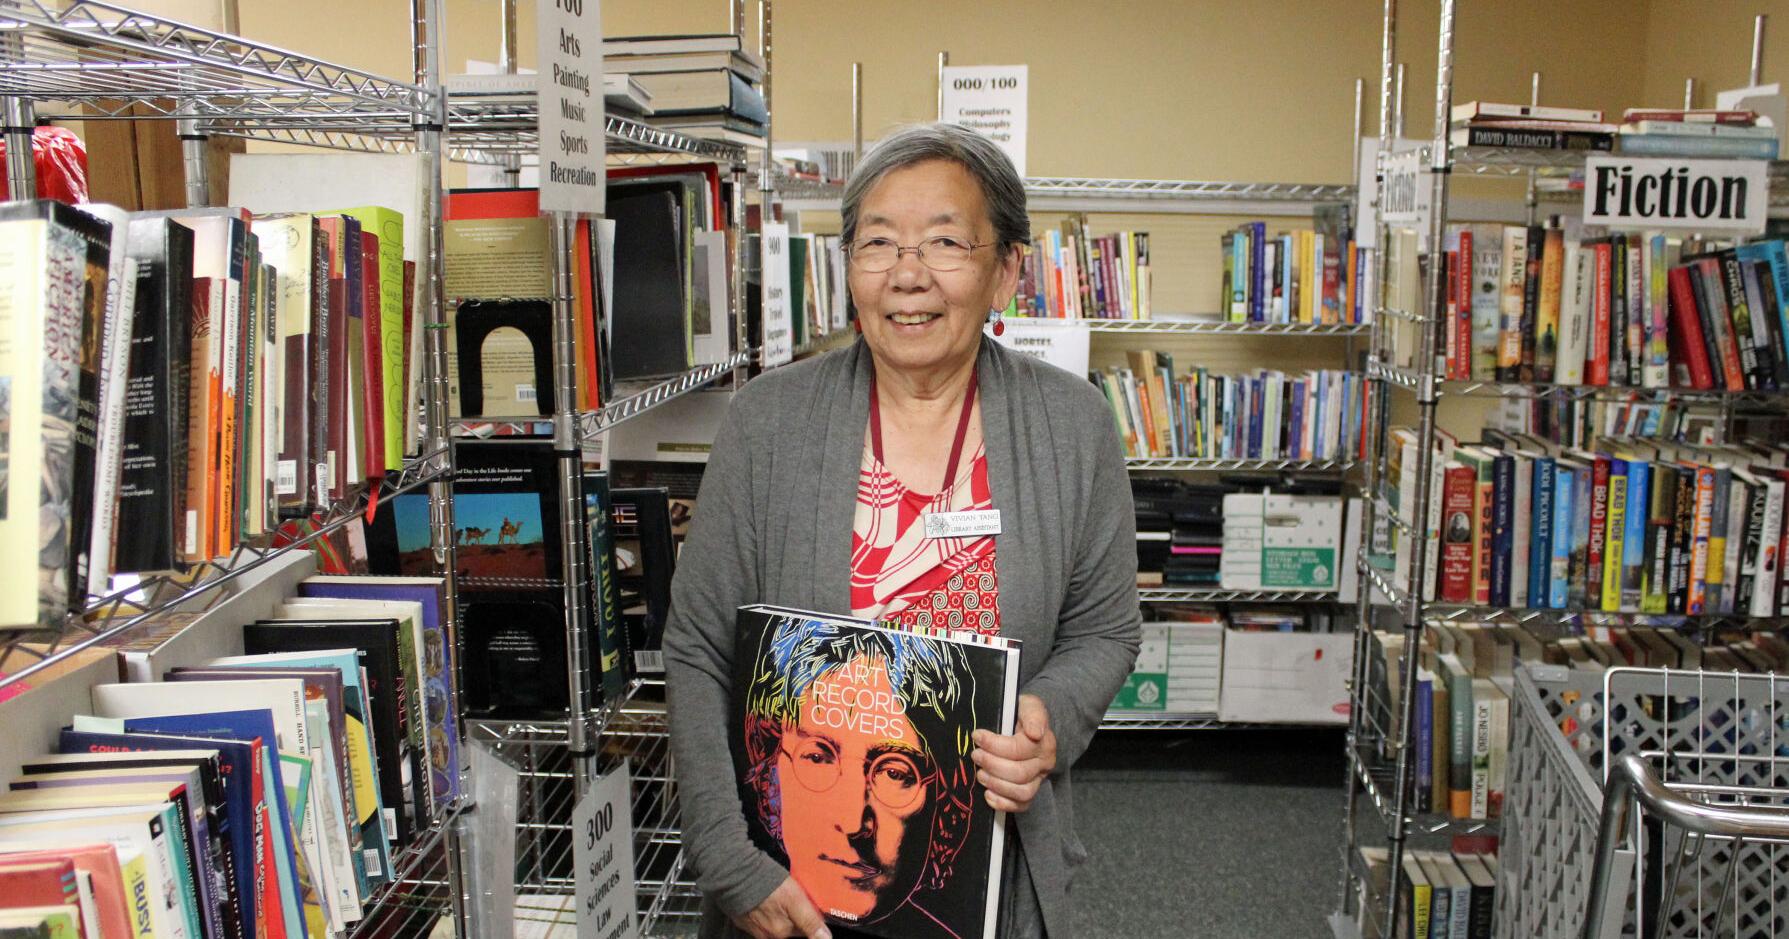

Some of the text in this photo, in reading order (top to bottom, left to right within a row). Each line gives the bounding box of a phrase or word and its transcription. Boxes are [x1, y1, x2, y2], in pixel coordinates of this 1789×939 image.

[560, 27, 580, 57] Arts
[553, 63, 589, 97] Painting
[954, 78, 1017, 90] 000/100
[561, 98, 585, 122] Music
[959, 108, 1011, 117] Computers
[560, 129, 587, 156] Sports
[1475, 131, 1552, 147] DAVID BALDACCI
[550, 161, 596, 186] Recreation
[1592, 165, 1749, 219] Fiction
[1510, 256, 1523, 289] JANCE
[45, 257, 62, 361] FICTION
[60, 255, 74, 379] AMERICAN
[118, 279, 134, 378] BILL BRYSON
[1538, 462, 1551, 538] JODI PICOULT
[1613, 479, 1625, 509] BRAD
[951, 514, 976, 522] VIVIAN
[1589, 485, 1606, 554] BRAD THOR
[1611, 510, 1623, 541] THOR
[1696, 488, 1713, 537] HARLAN
[1746, 494, 1765, 545] KOONTZ
[1480, 490, 1492, 583] YONDER
[837, 663, 884, 688] ART
[813, 680, 908, 716] RECORD
[296, 722, 304, 744] HAND
[811, 704, 905, 740] COVERS
[408, 688, 424, 732] City
[418, 756, 433, 817] Bones
[1474, 774, 1484, 807] POLICE
[254, 800, 264, 833] DOG
[587, 801, 613, 851] 300
[255, 835, 265, 864] MAN
[590, 843, 613, 882] Social
[133, 880, 152, 936] BUSY
[587, 869, 620, 916] Sciences
[597, 907, 612, 933] Law
[829, 907, 859, 922] TASCHEN
